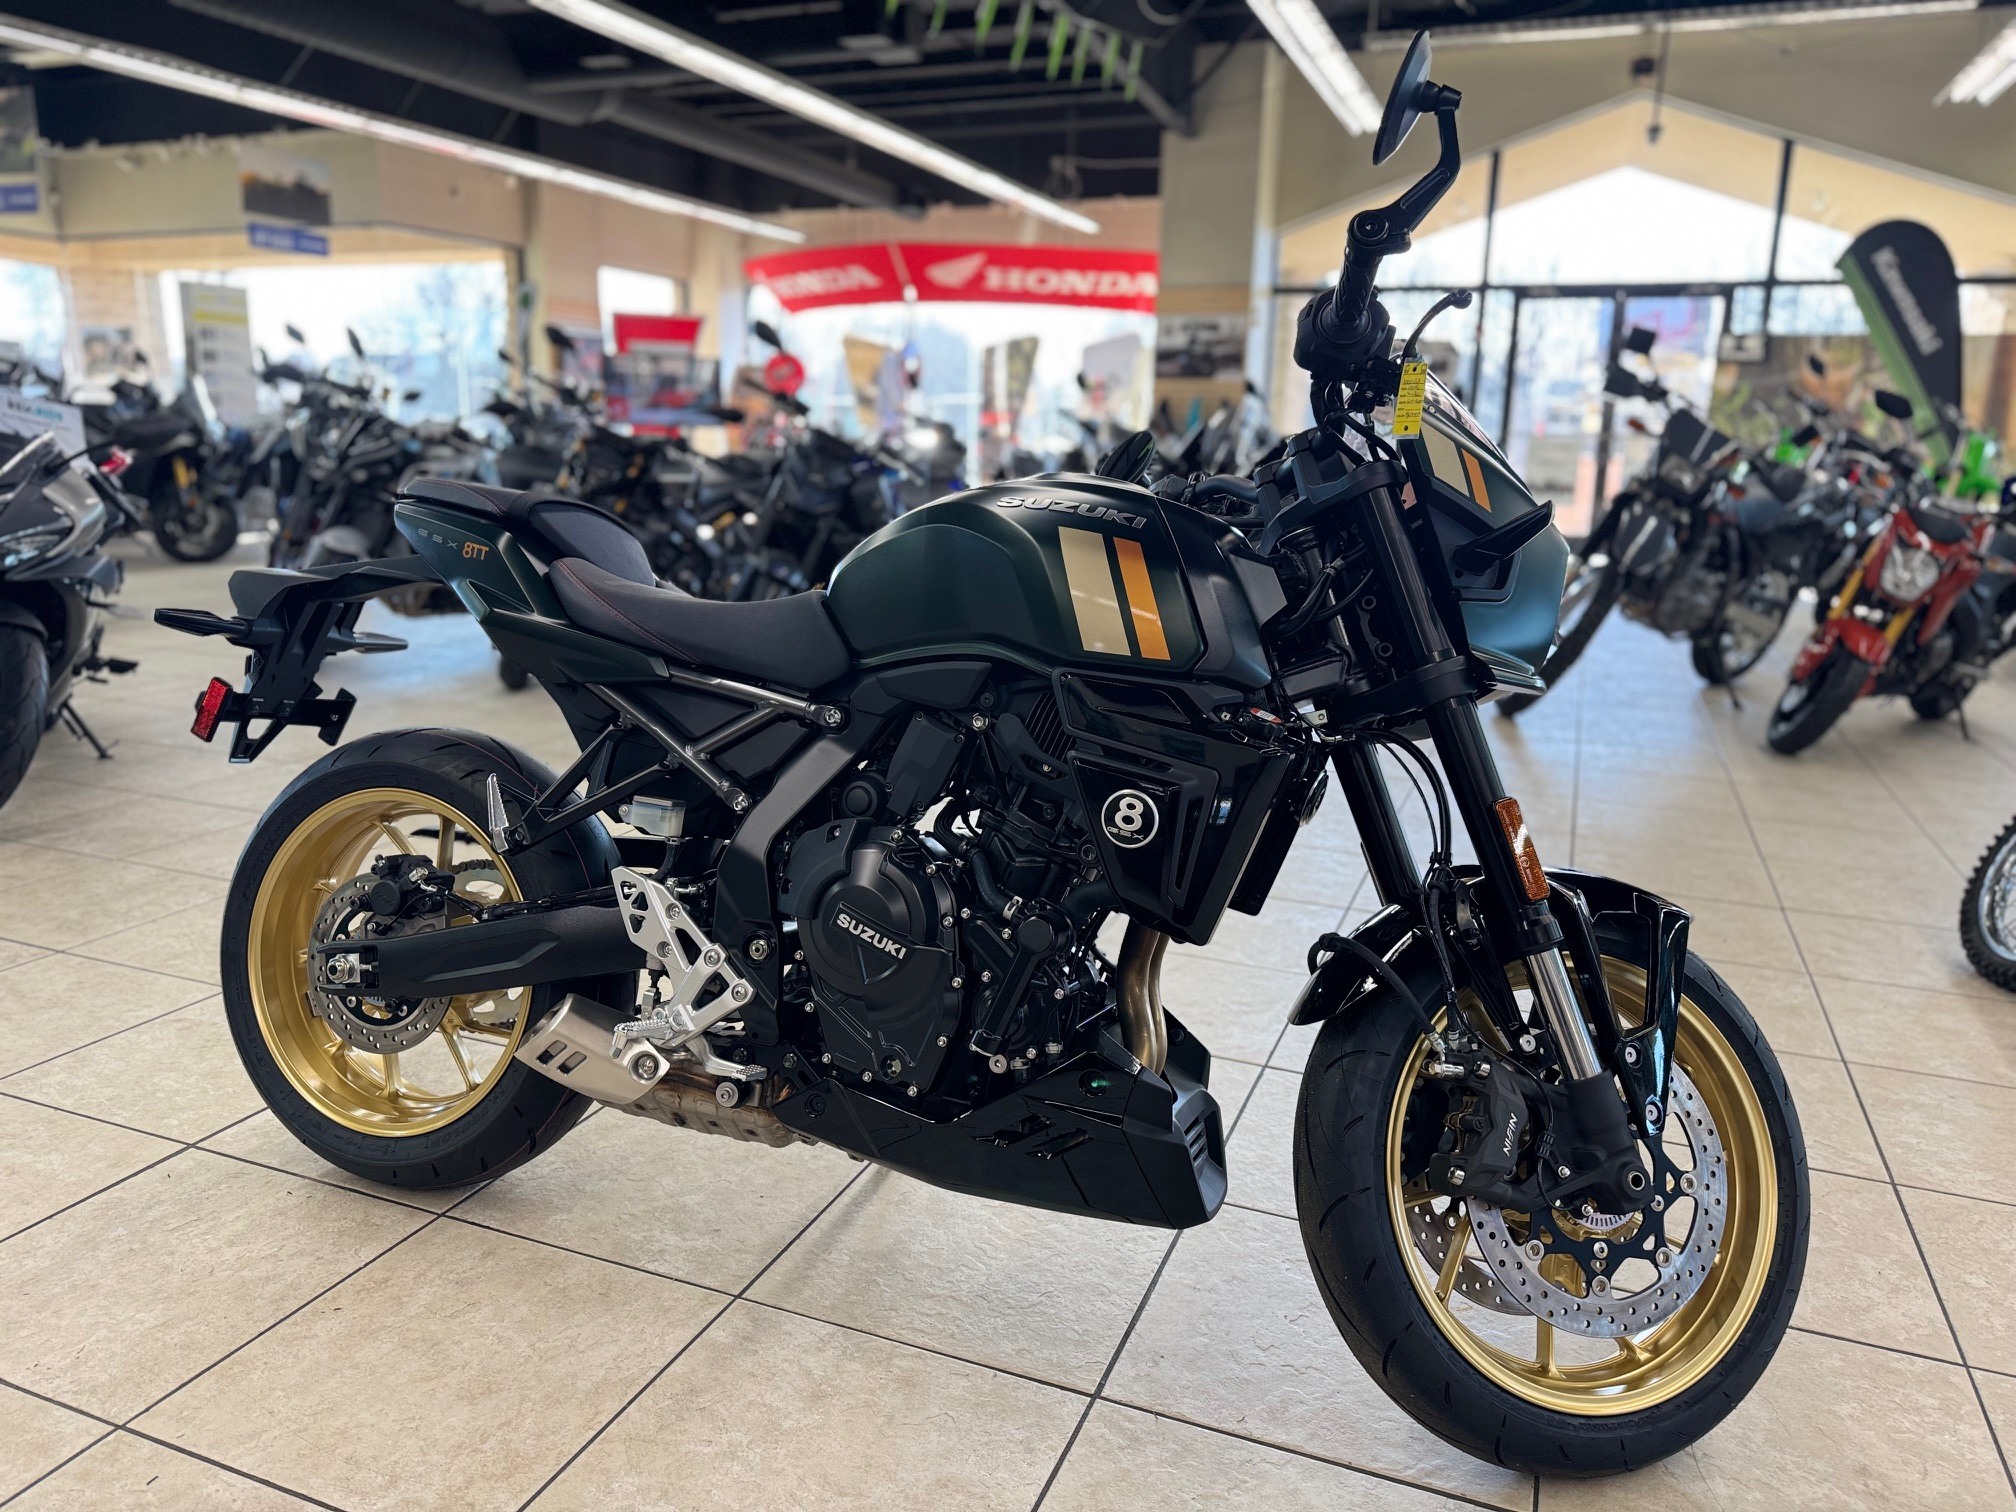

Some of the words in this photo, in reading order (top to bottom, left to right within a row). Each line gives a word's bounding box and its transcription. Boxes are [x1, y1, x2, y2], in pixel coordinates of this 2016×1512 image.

[983, 265, 1158, 298] HONDA
[996, 496, 1147, 529] SUZUKI
[462, 541, 489, 560] 8TT
[1114, 796, 1144, 831] 8
[836, 913, 907, 960] SUZUKI
